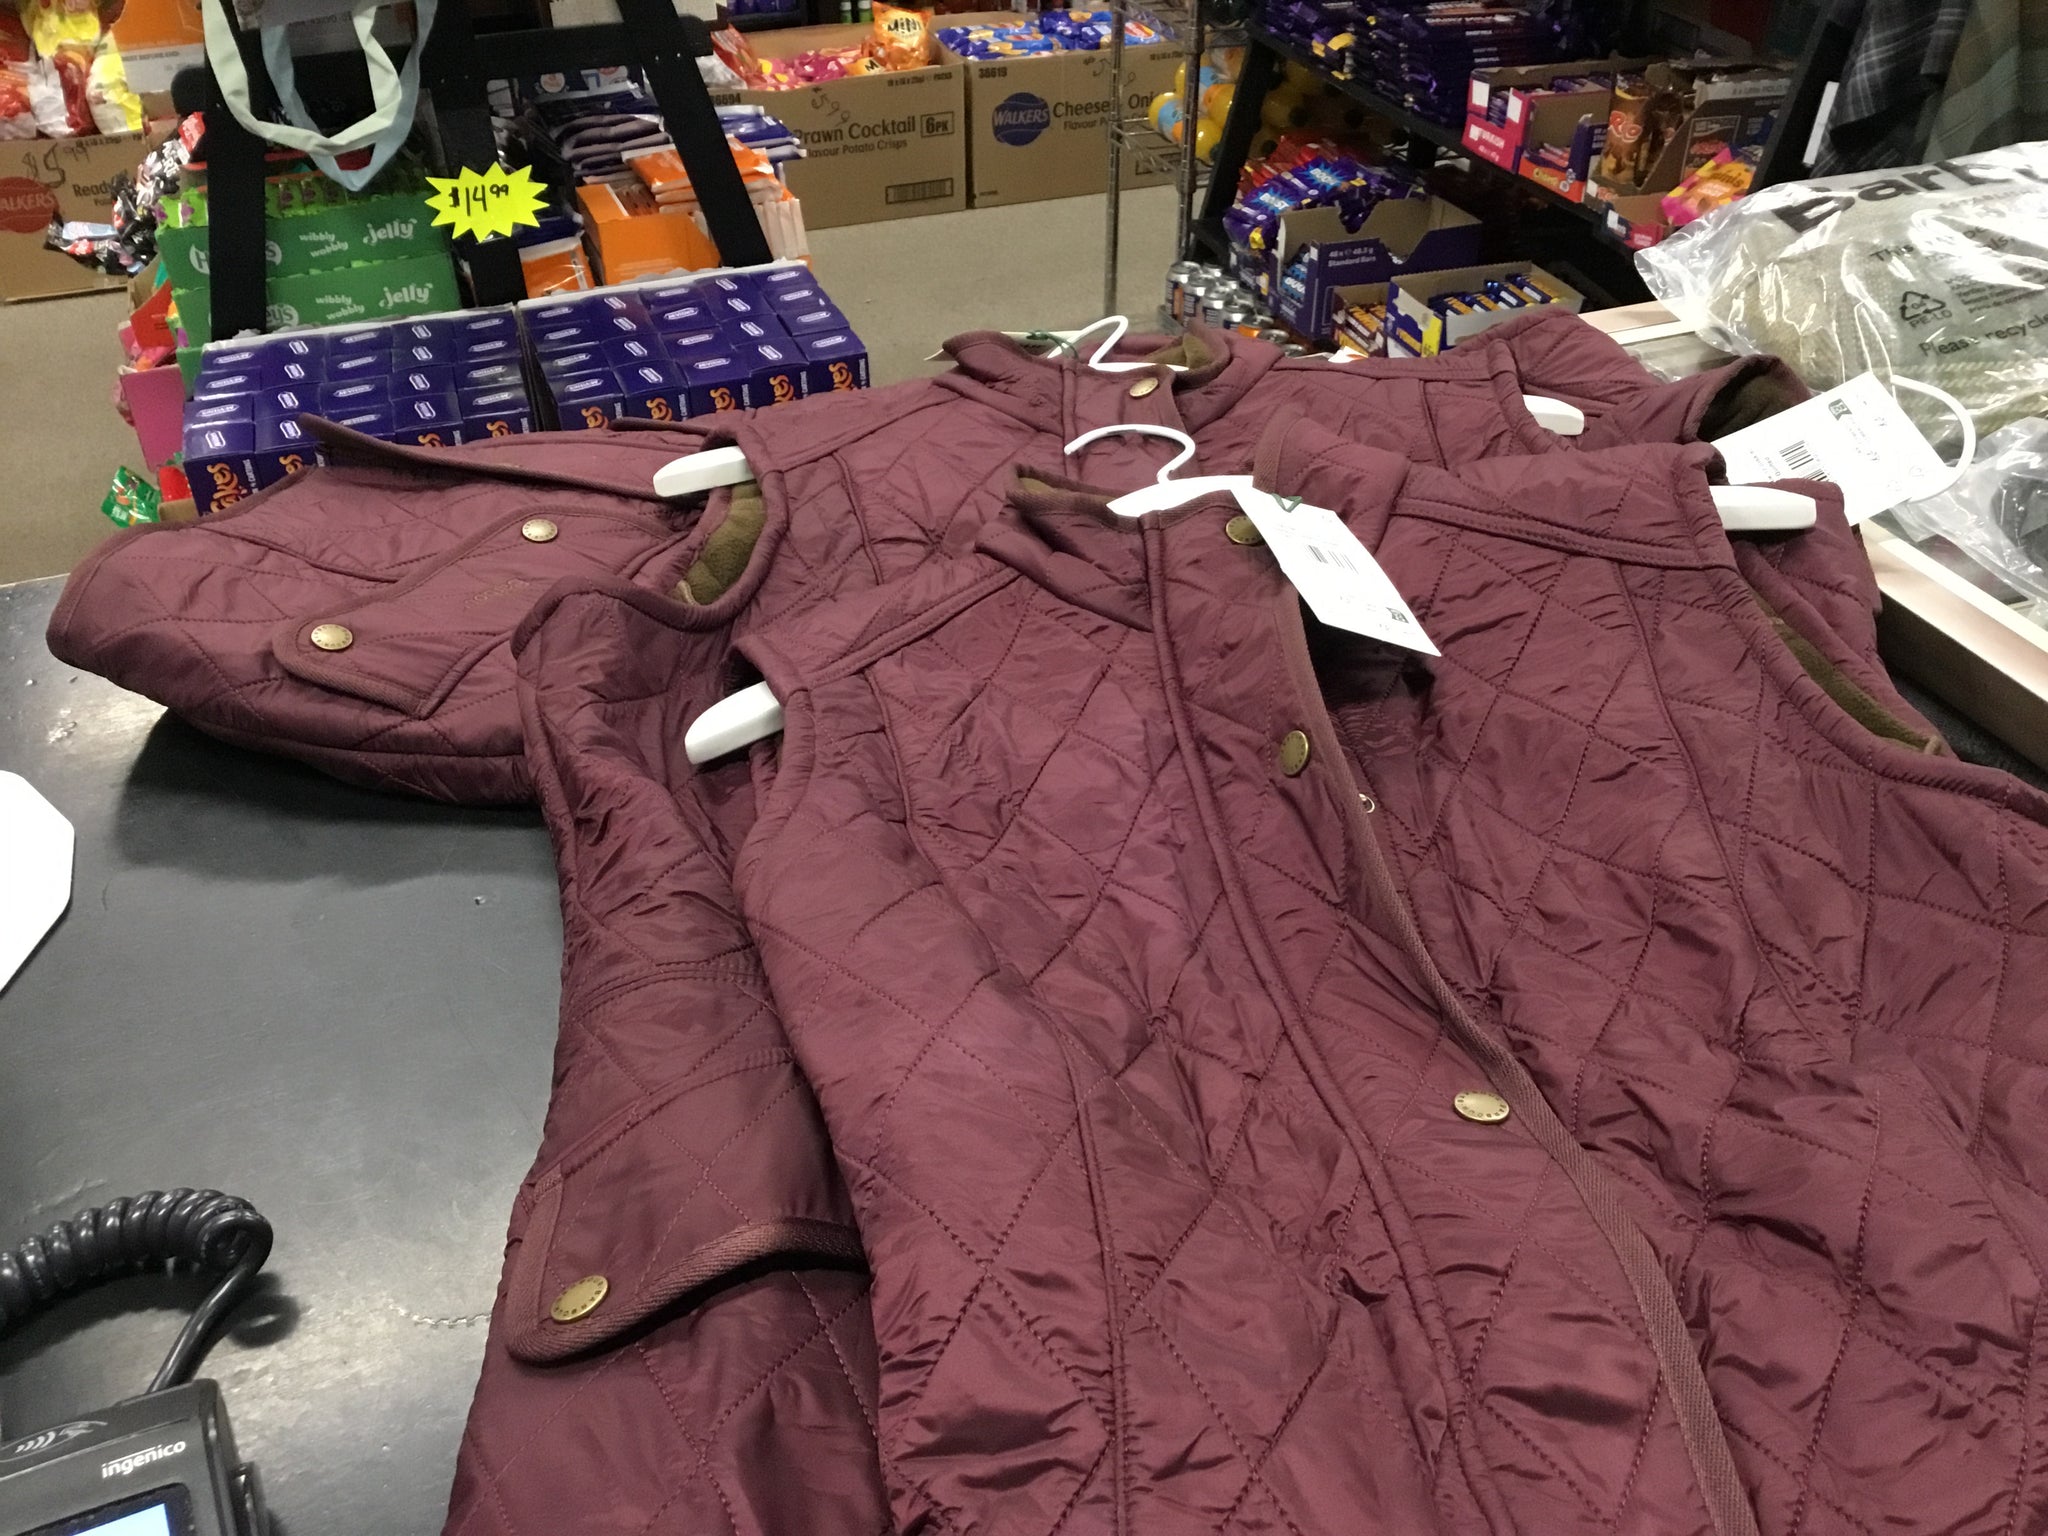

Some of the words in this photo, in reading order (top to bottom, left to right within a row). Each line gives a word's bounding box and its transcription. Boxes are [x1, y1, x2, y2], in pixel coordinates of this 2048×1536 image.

[994, 108, 1049, 127] WALKERS
[1053, 100, 1111, 118] Cheese
[848, 116, 916, 140] Cocktail
[810, 145, 840, 158] lavour
[842, 142, 875, 155] Potato
[876, 138, 908, 152] Crisps
[0, 193, 54, 212] ALKERS
[299, 230, 336, 243] wibbly
[366, 219, 416, 246] jelly
[309, 240, 349, 258] wobbly
[316, 293, 352, 305] wibbly
[382, 284, 432, 309] jelly
[326, 302, 366, 321] wobbly
[101, 1441, 186, 1479] ingenico
